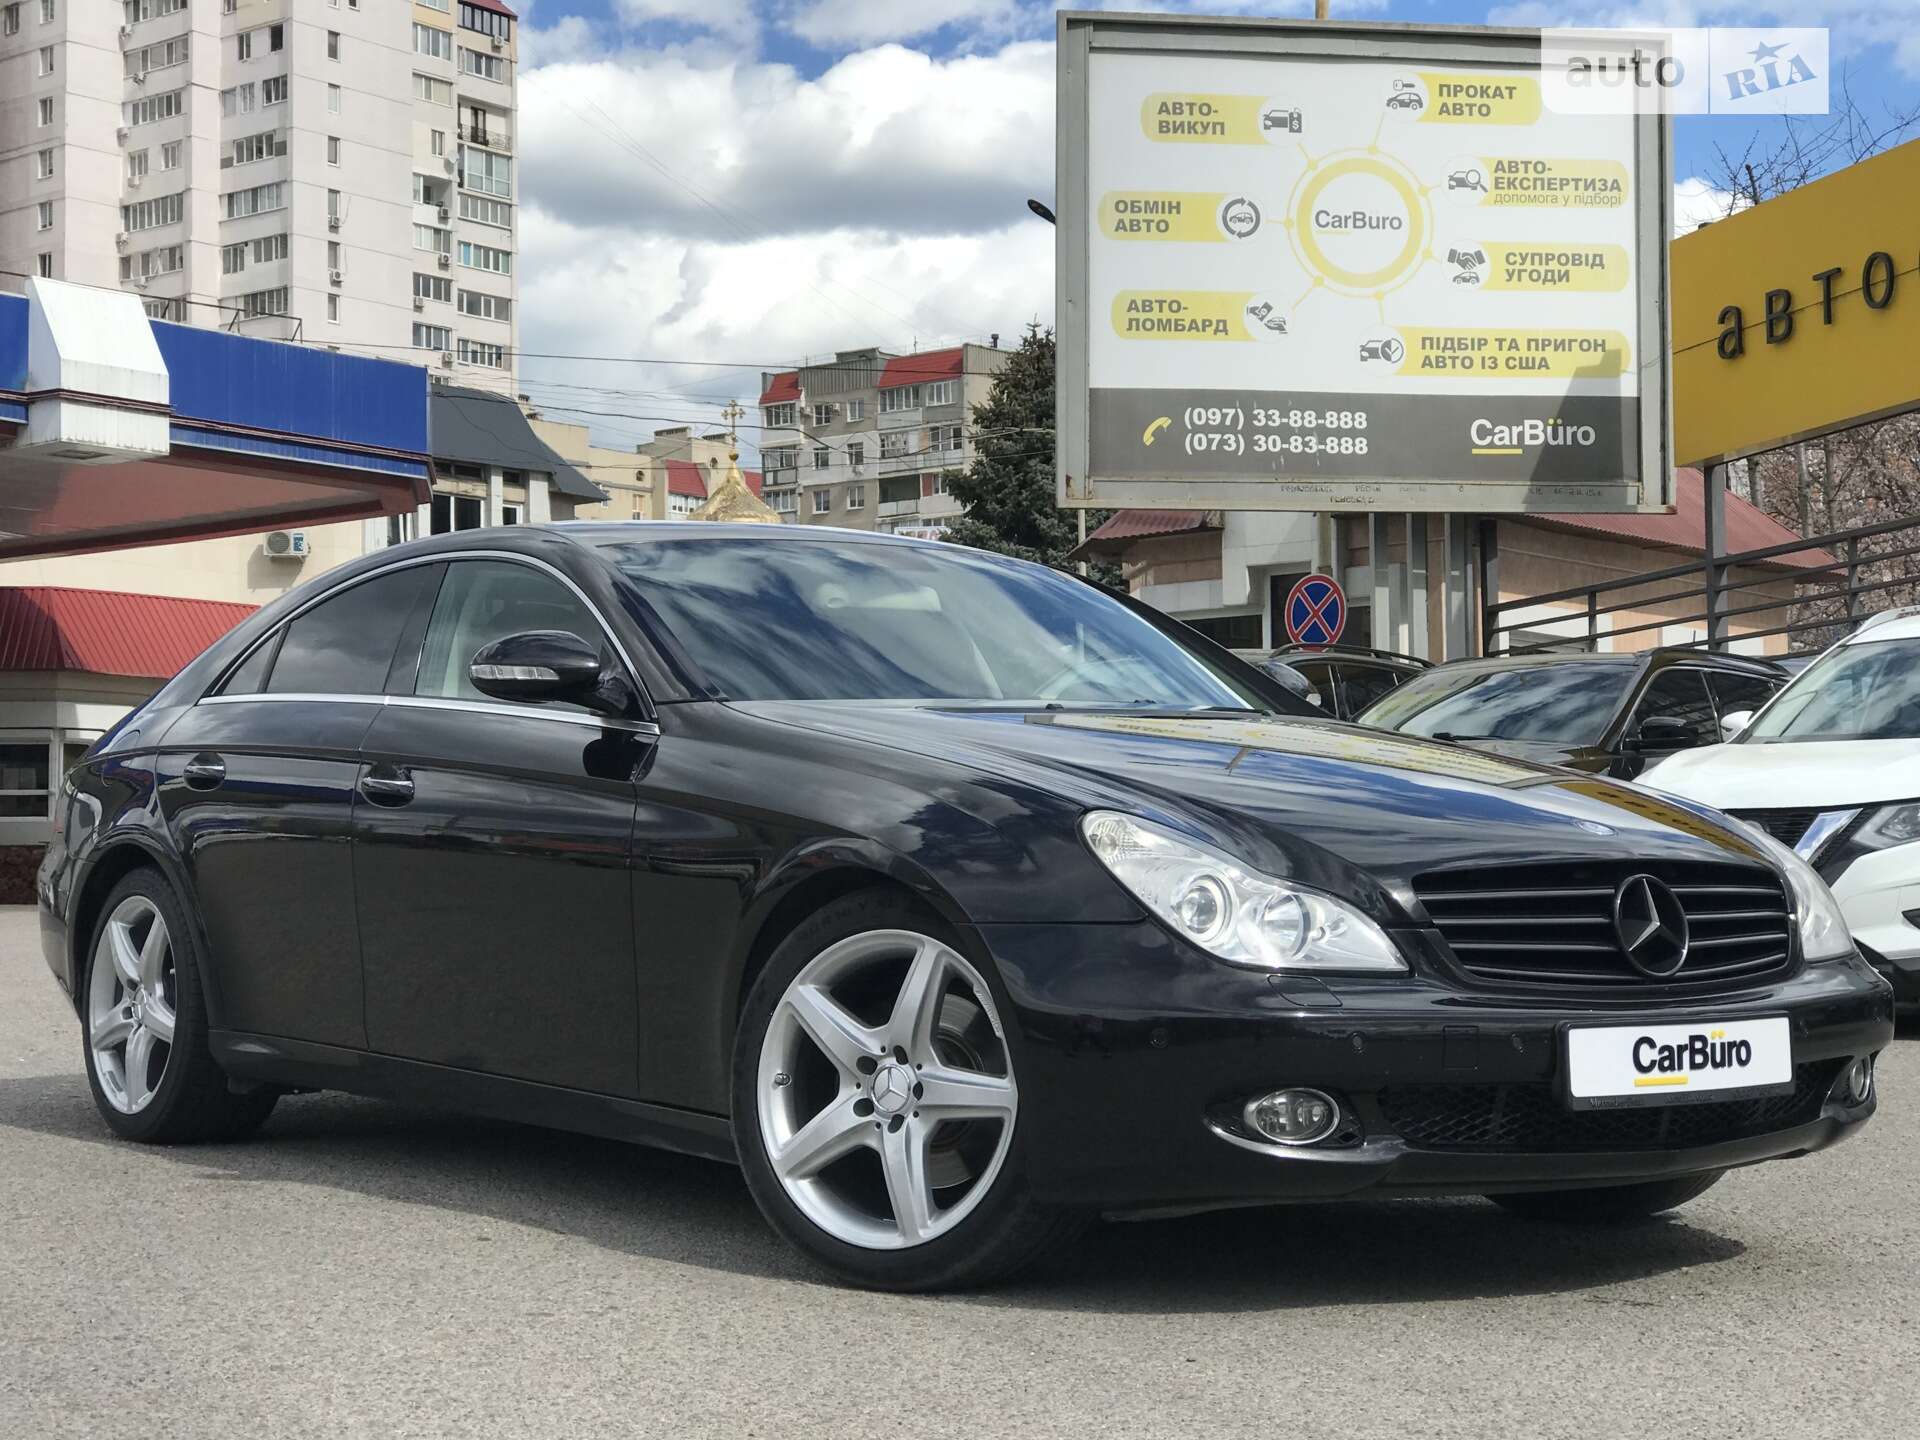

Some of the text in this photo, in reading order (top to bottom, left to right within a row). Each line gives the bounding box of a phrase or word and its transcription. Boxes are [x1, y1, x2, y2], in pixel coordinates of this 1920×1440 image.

[1438, 83, 1517, 100] ПРОКАТ
[1157, 101, 1219, 118] АВТО-
[1438, 102, 1492, 118] АВТО
[1157, 120, 1226, 136] ВИКУП
[1493, 160, 1553, 175] АВТО-
[1493, 176, 1622, 192] ЕКСПЕРТИЗА
[1114, 199, 1181, 216] ОБМІН
[1494, 192, 1623, 208] допомога у підборі
[1114, 218, 1170, 234] АВТО
[1505, 252, 1605, 270] СУПРОВІД
[1505, 269, 1571, 285] УГОДИ
[1126, 299, 1189, 314] АВТО-
[1126, 317, 1229, 336] ЛОМБАРД
[1421, 336, 1607, 353] ПІДБІР ТА ПРИГОН
[1420, 356, 1550, 371] АВТО ІЗ США
[1184, 407, 1368, 430] (097) 33-88-888
[1470, 418, 1596, 446] CarBüro
[1184, 433, 1368, 456] (073) 30-83-888
[1632, 1029, 1752, 1075] CarBüro
